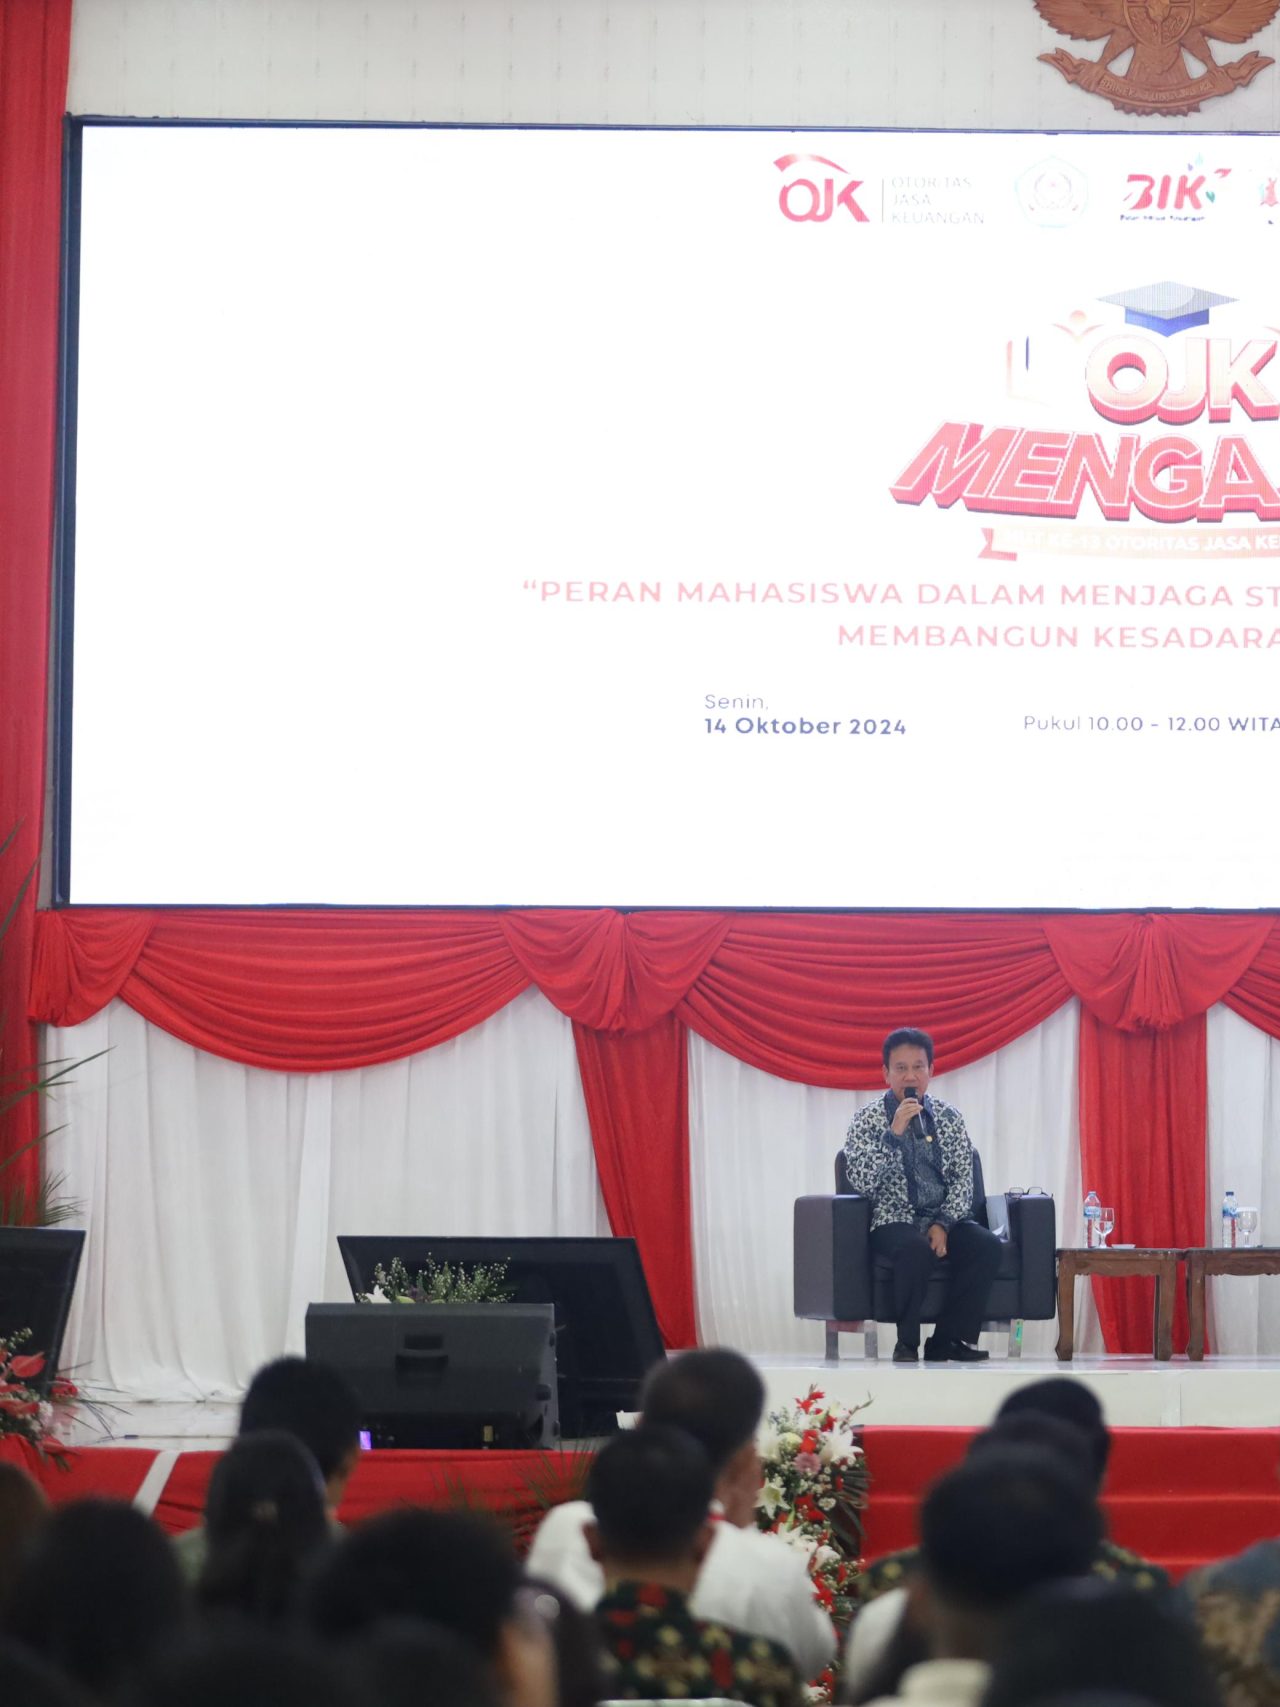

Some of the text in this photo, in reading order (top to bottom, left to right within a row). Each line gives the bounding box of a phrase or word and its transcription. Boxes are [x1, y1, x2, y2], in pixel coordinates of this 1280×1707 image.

[777, 177, 871, 223] OJK
[1105, 535, 1200, 551] OTORITAS
[1204, 535, 1252, 551] JASA
[676, 582, 903, 605] MAHASISWA
[916, 584, 1044, 606] DALAM
[1060, 585, 1233, 607] MENJAGA
[837, 624, 1079, 648] MEMBANGUN
[704, 694, 769, 712] Senin,
[704, 716, 907, 735] 14 Oktober 2024
[1024, 715, 1081, 731] Pukul
[1088, 716, 1145, 732] 10.00
[1167, 716, 1221, 733] 12.00
